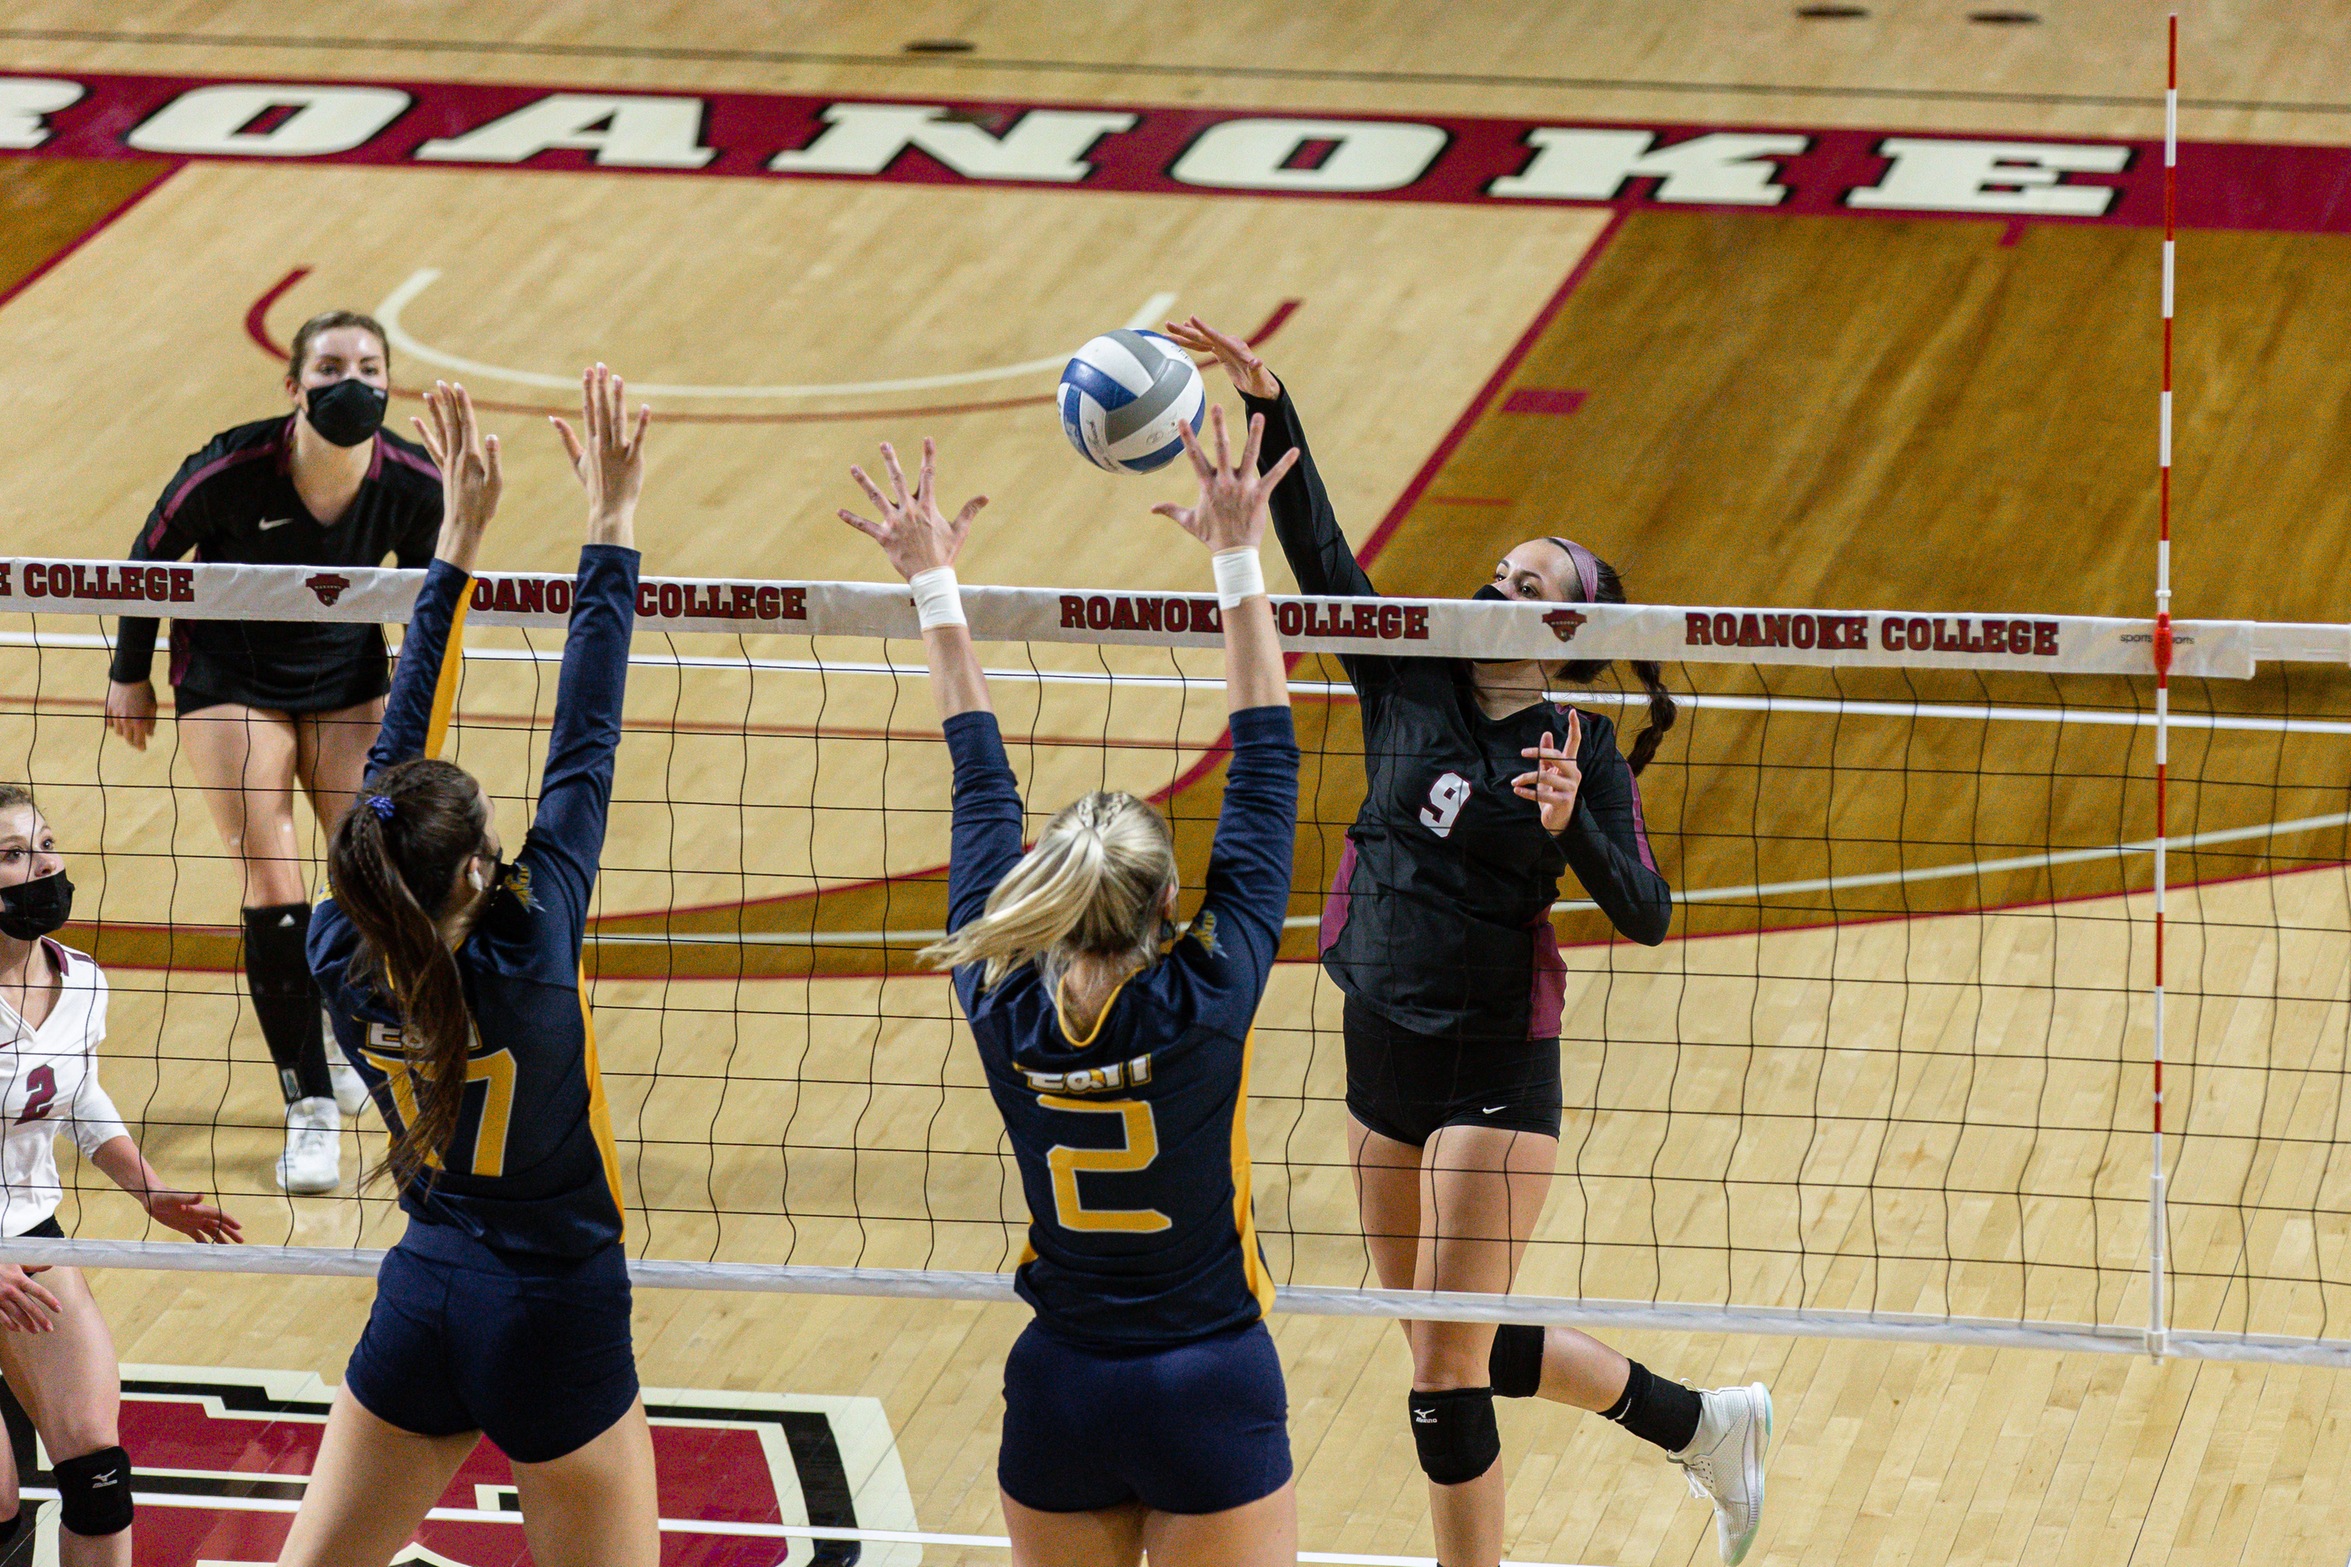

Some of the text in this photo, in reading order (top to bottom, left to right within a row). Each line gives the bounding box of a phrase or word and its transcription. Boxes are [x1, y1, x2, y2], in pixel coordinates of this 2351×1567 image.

[23, 563, 195, 602] COLLEGE
[470, 577, 807, 620] OANO COLLEGE
[1685, 612, 2059, 656] ROANOKE COLLEGE
[1418, 771, 1472, 838] 9
[13, 1064, 58, 1126] 2
[1036, 1094, 1173, 1234] 2
